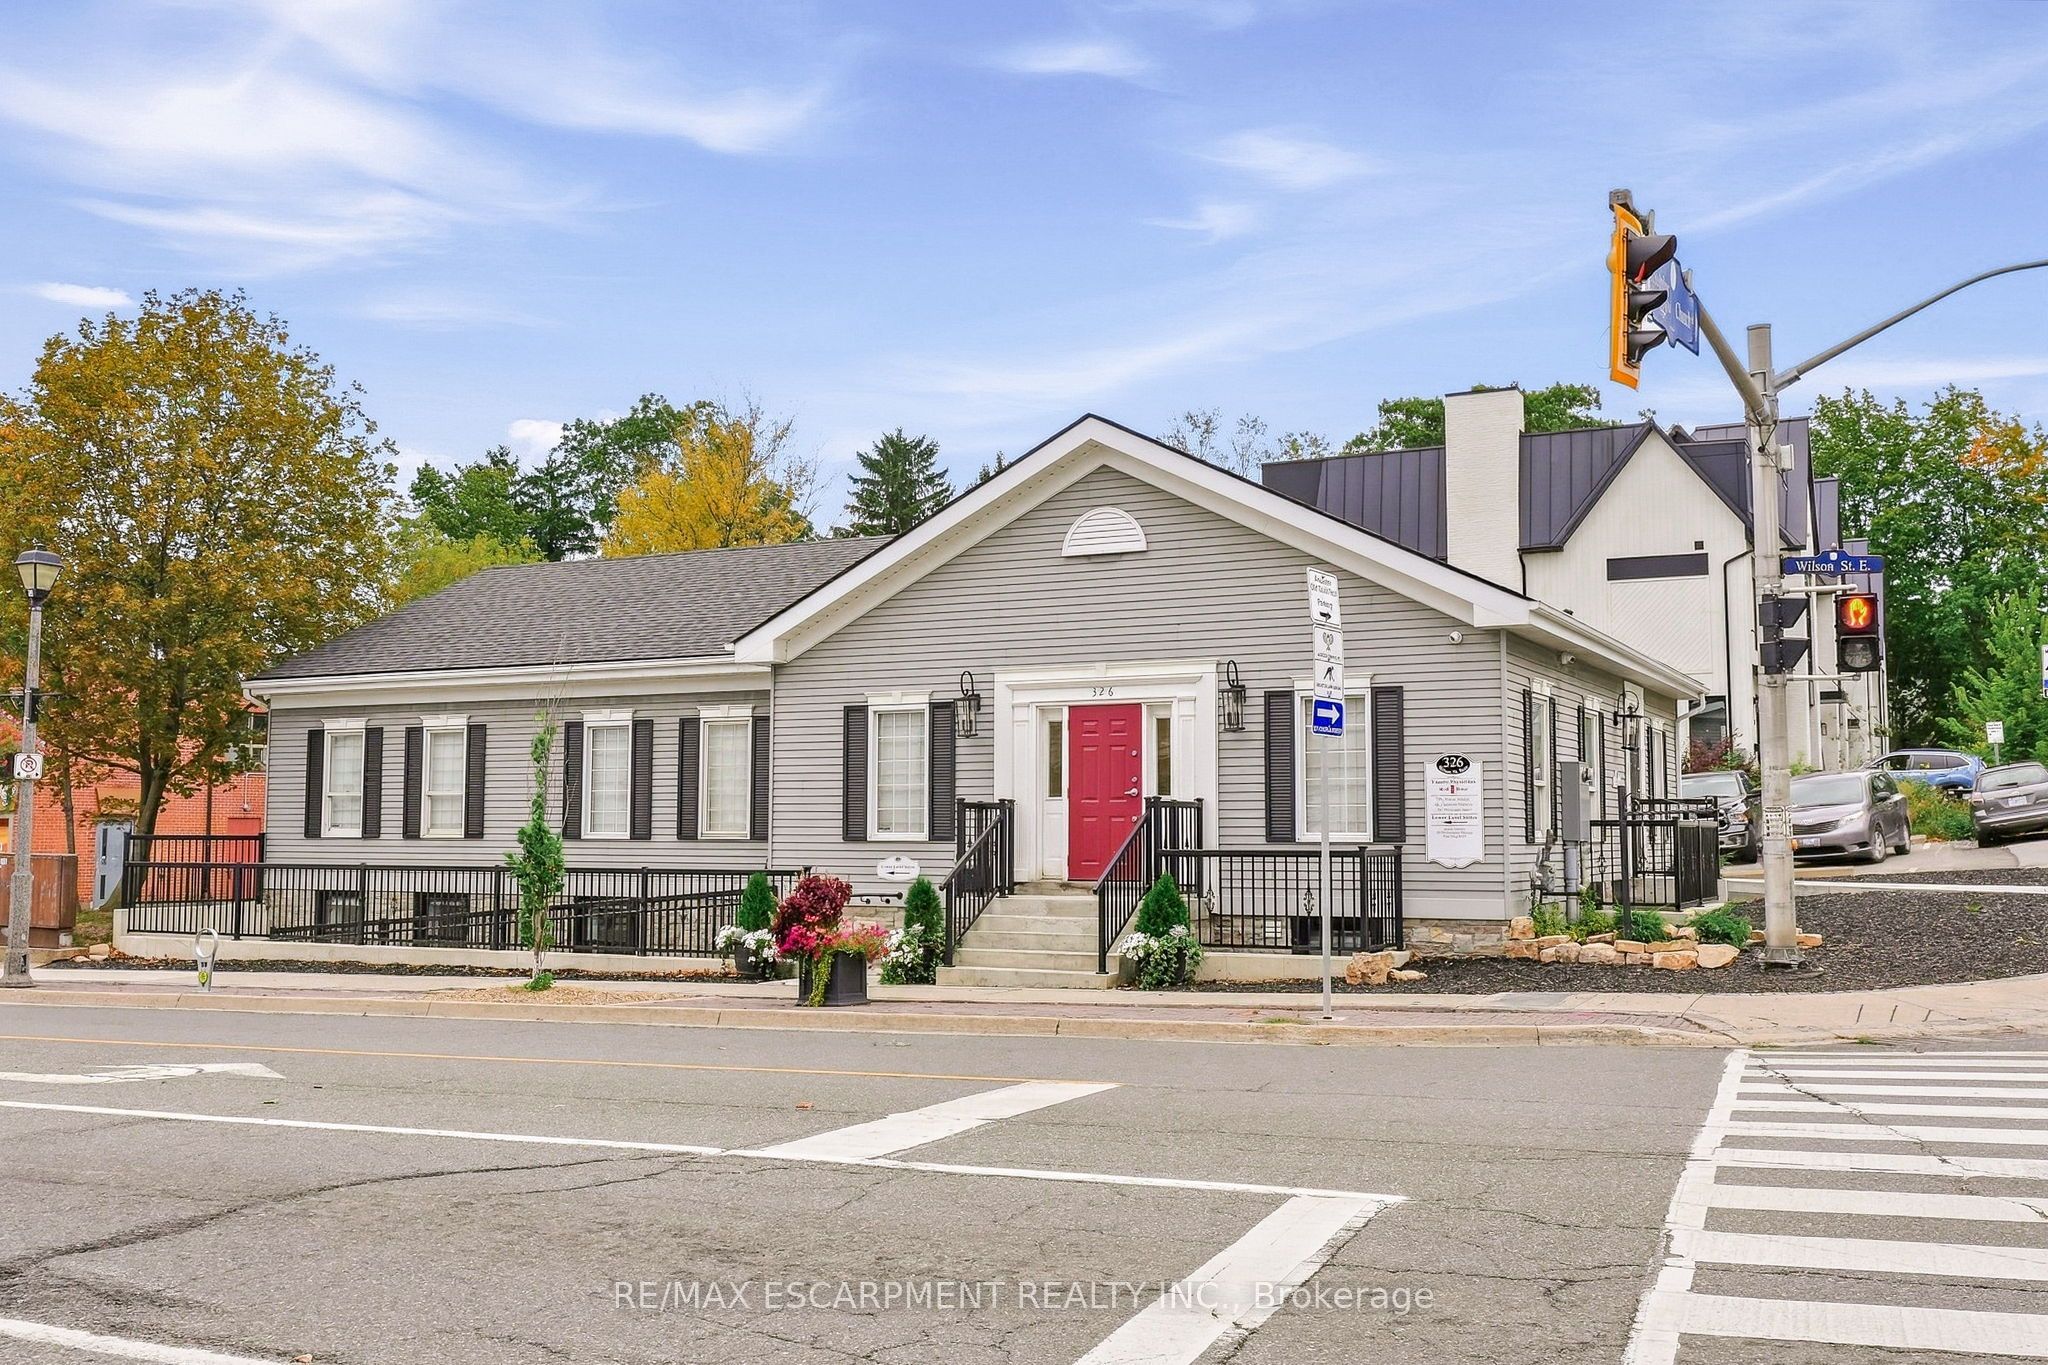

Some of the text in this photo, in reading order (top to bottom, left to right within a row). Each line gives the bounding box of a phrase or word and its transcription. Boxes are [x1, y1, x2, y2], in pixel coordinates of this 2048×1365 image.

[1796, 560, 1871, 571] Wilson St. E.
[1092, 687, 1114, 697] 326
[1442, 756, 1464, 768] 326
